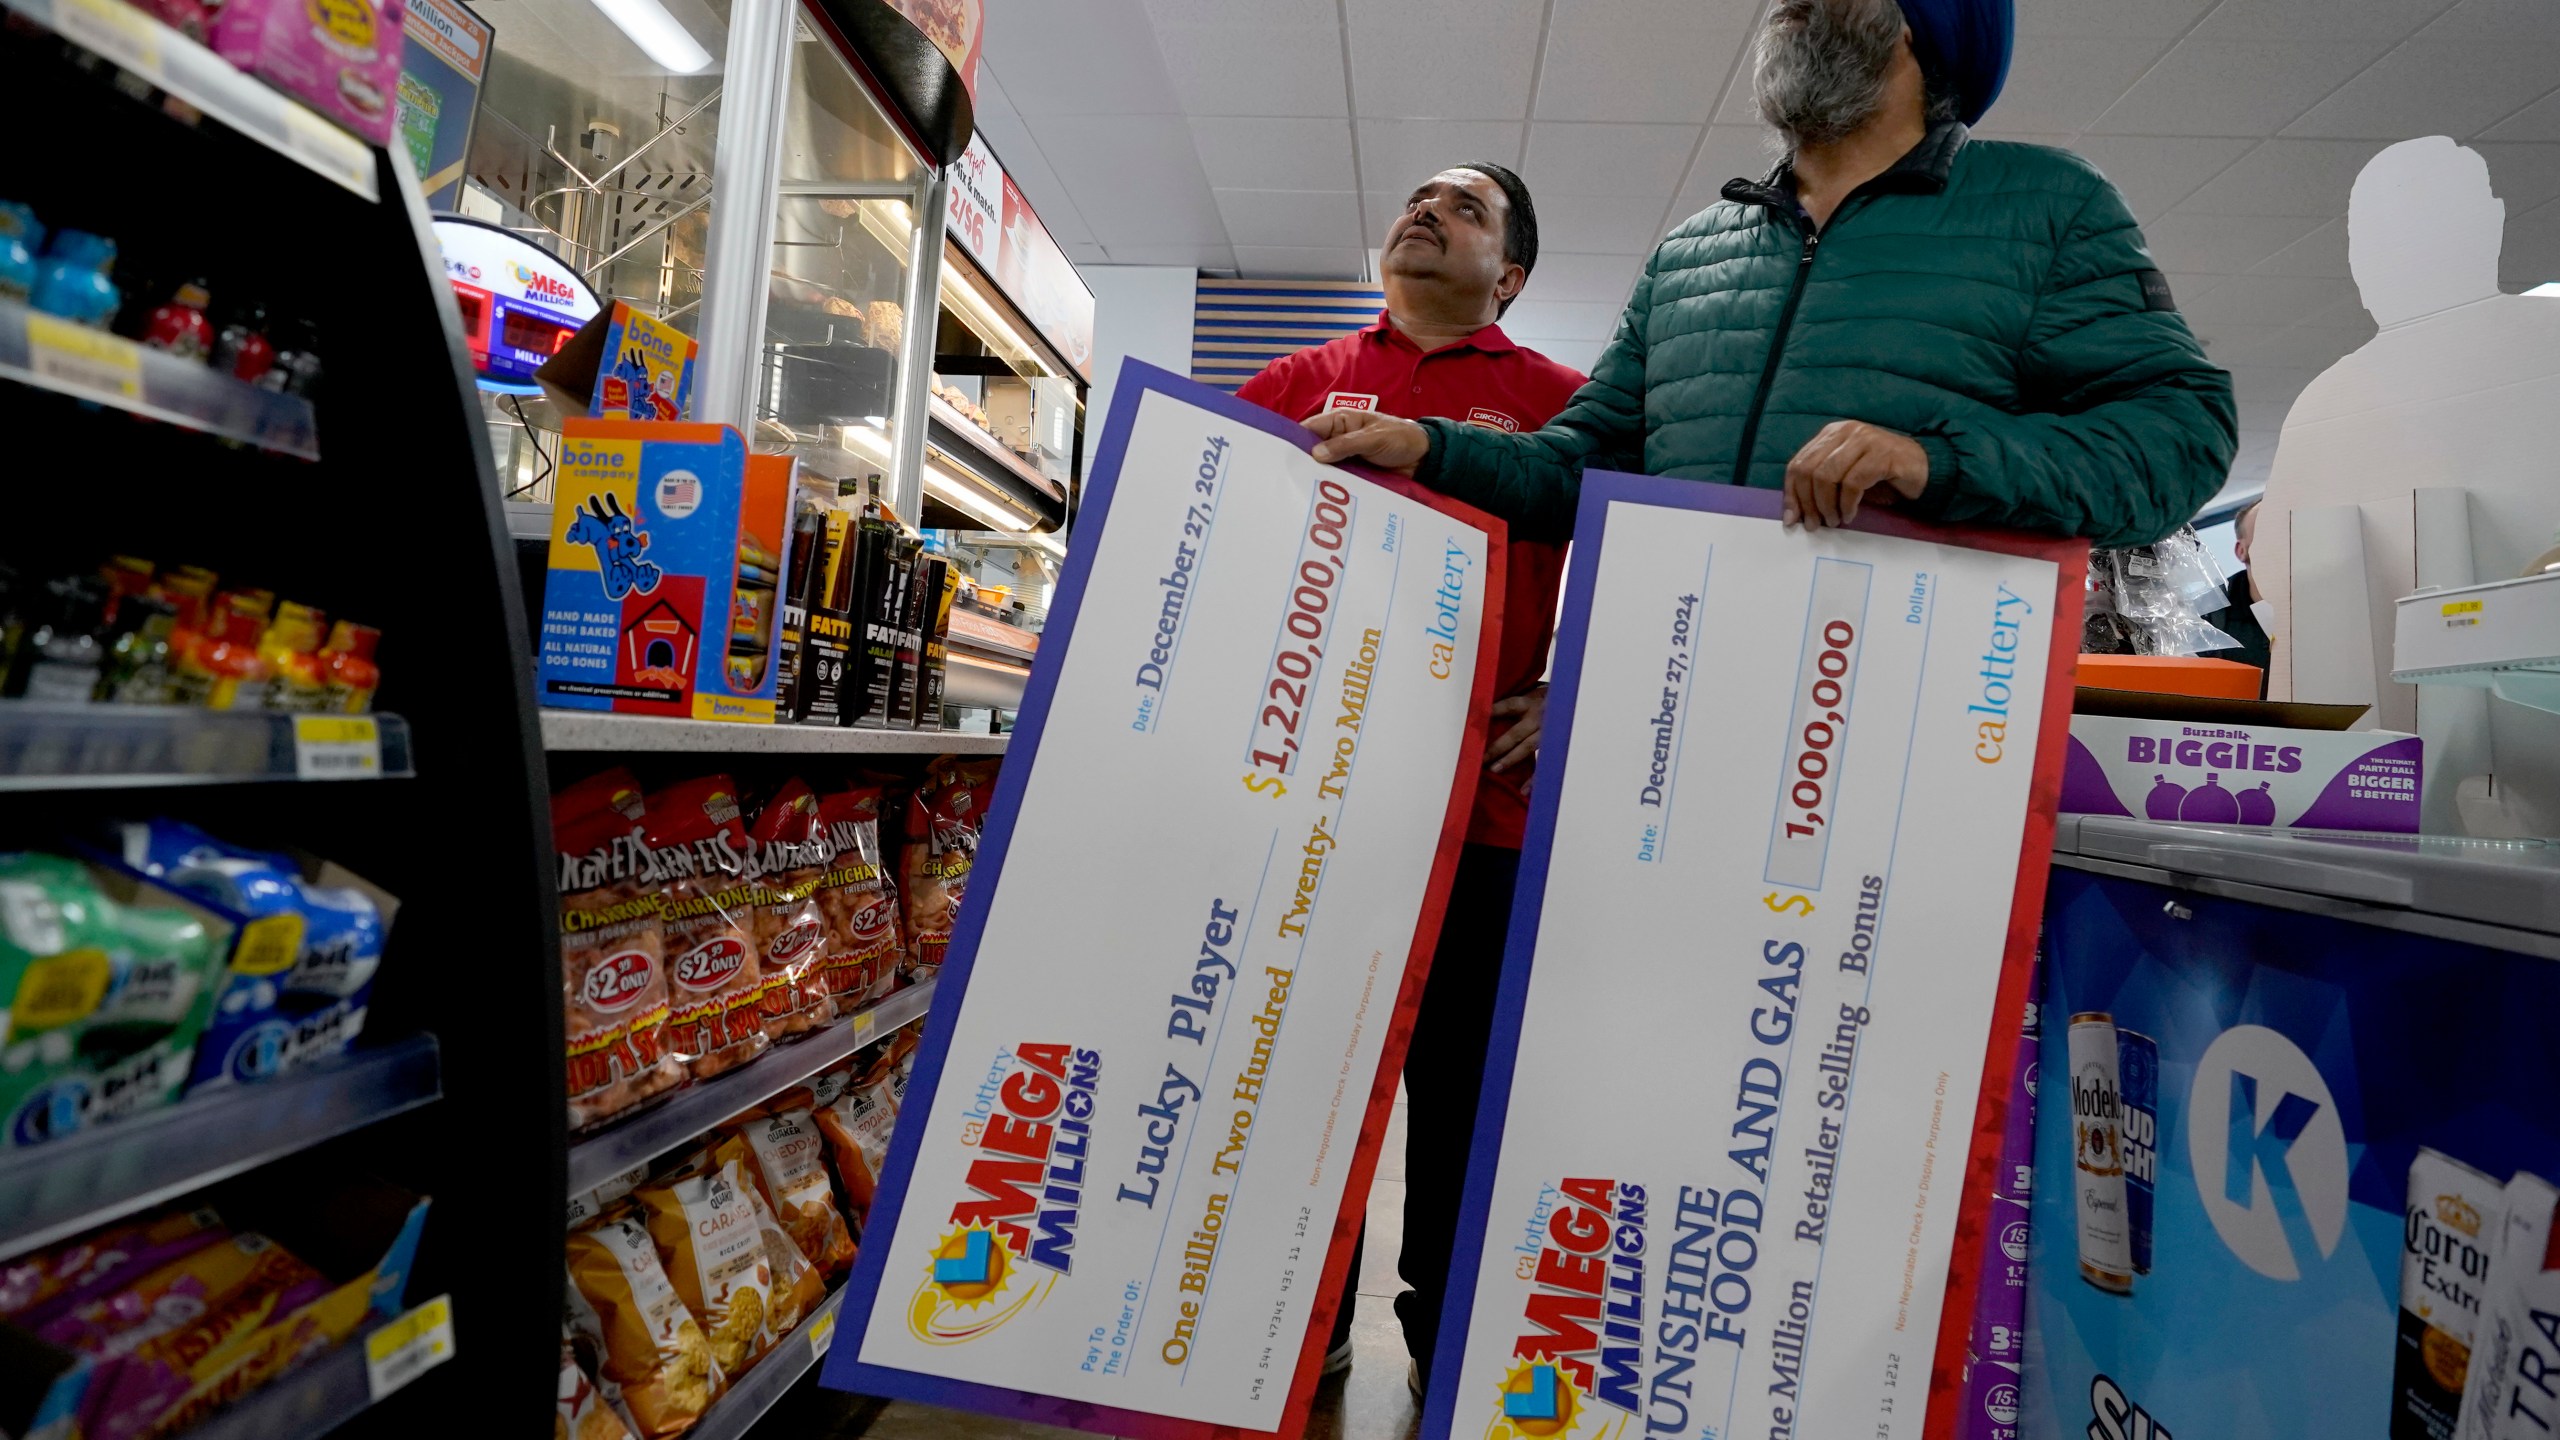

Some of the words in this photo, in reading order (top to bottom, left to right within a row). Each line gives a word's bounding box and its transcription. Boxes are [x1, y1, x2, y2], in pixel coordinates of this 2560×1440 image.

[953, 161, 967, 187] Mix
[950, 186, 984, 256] 2/$6
[525, 290, 575, 308] MILLIONS
[528, 271, 575, 301] MEGA
[628, 316, 673, 358] bone
[1335, 398, 1358, 408] CIRCLE
[1473, 411, 1504, 426] CIRCLE
[562, 443, 625, 468] bone
[573, 468, 635, 481] company
[1195, 434, 1231, 498] 2024
[1185, 501, 1213, 540] 27,
[1381, 511, 1398, 554] Dollars
[547, 610, 580, 622] HAND
[583, 612, 615, 625] MADE
[1136, 540, 1197, 693] December
[1425, 537, 1472, 680] calottery
[1905, 571, 1928, 625] Dollars
[544, 624, 577, 636] FRESH
[580, 625, 617, 638] BAKED
[810, 614, 852, 640] FATTY
[1251, 480, 1350, 775] 1,220,000,000
[1672, 593, 1699, 648] 2024
[544, 641, 562, 652] ALL
[565, 643, 612, 656] NATURAL
[546, 656, 569, 667] DOG
[572, 657, 608, 669] BONES
[1336, 627, 1382, 734] Million
[1666, 653, 1689, 684] 27,
[1967, 582, 2032, 765] calottery
[712, 698, 745, 716] bone
[1132, 694, 1155, 733] Date:
[1640, 686, 1679, 809] December
[1785, 620, 1855, 840] 1,000,000
[2182, 726, 2251, 741] BuzzBallz
[1318, 737, 1355, 801] Two
[2127, 736, 2303, 774] BIGGIES
[2358, 763, 2391, 774] PARTY
[2391, 765, 2416, 775] BALL
[2384, 758, 2416, 766] ULTIMATE
[1242, 772, 1288, 799] $
[2347, 774, 2415, 790] BIGGER
[2351, 789, 2363, 799] IS
[2364, 790, 2415, 802] BETTER!
[1638, 824, 1658, 862] Date:
[1763, 891, 1815, 918] $
[1839, 874, 1883, 976] Bonus
[619, 968, 650, 993] ONLY
[711, 952, 742, 974] ONLY
[1750, 938, 1805, 1047] GAS
[1116, 1062, 1201, 1210] Lucky
[1167, 897, 1239, 1046] Player
[1233, 966, 1294, 1105] Hundred
[1817, 1002, 1871, 1111] Selling
[2071, 1076, 2122, 1121] Modelo
[766, 1124, 801, 1144] QUAKER
[1728, 1056, 1784, 1185] AND
[763, 1136, 820, 1162] CHEDDAR
[948, 1042, 1073, 1258] MEGA
[1031, 1048, 1100, 1274] MILLIONS
[1212, 1110, 1252, 1177] Two
[1795, 1118, 1842, 1246] Retailer
[2013, 1165, 2032, 1190] 3
[1179, 1194, 1229, 1297] Billion
[1513, 1177, 1616, 1395] MEGA
[1704, 1188, 1764, 1349] FOOD
[1126, 1280, 1143, 1303] Of:
[1599, 1182, 1648, 1415] MILLIONS
[1090, 1326, 1106, 1344] To
[1110, 1307, 1136, 1356] Order
[1162, 1301, 1200, 1367] One
[1768, 1281, 1813, 1403] Million
[1989, 1325, 2011, 1351] 3
[1082, 1342, 1104, 1373] Pay
[1103, 1357, 1118, 1376] The
